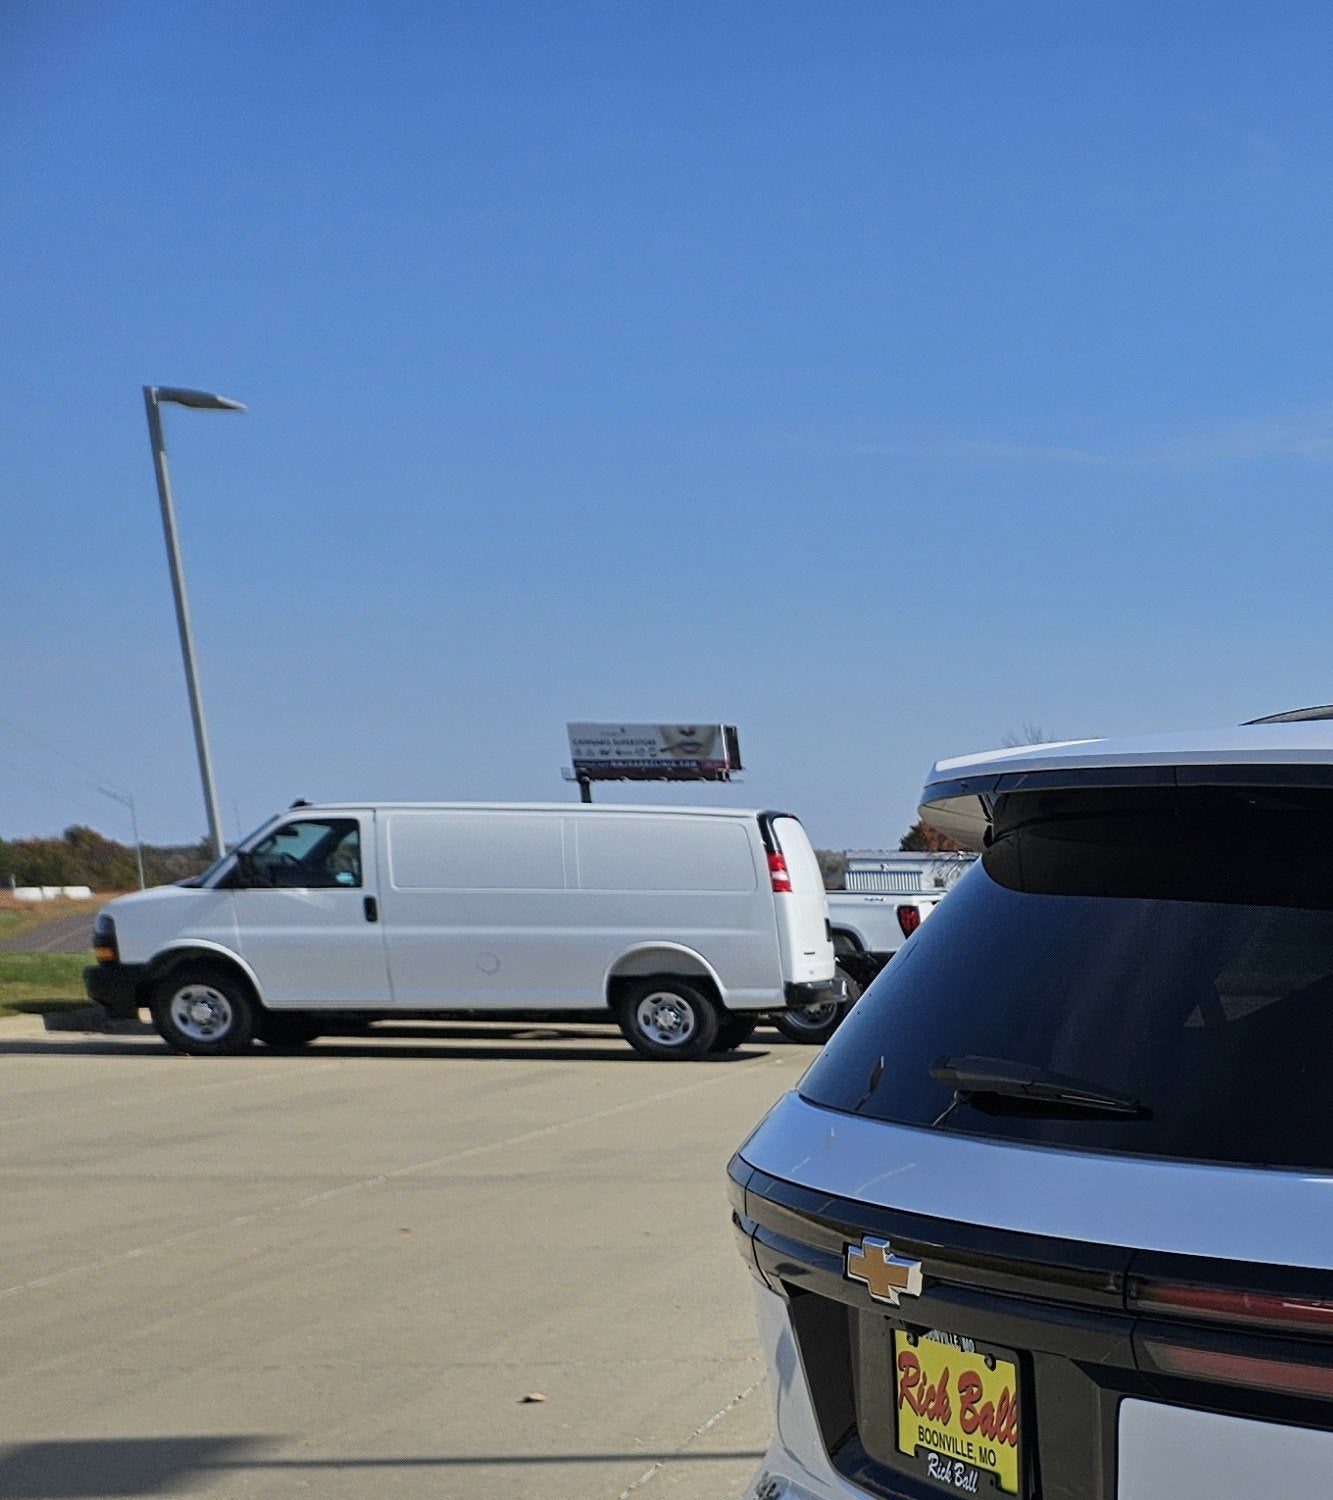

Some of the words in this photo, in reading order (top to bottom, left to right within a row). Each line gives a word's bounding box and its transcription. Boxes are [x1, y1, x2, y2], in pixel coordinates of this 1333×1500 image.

[898, 1351, 952, 1425] Rick
[958, 1370, 1018, 1447] Ball
[918, 1425, 977, 1463] BOONVILLE,
[979, 1446, 997, 1468] MO
[927, 1452, 953, 1484] Rick
[954, 1462, 979, 1493] Ball
